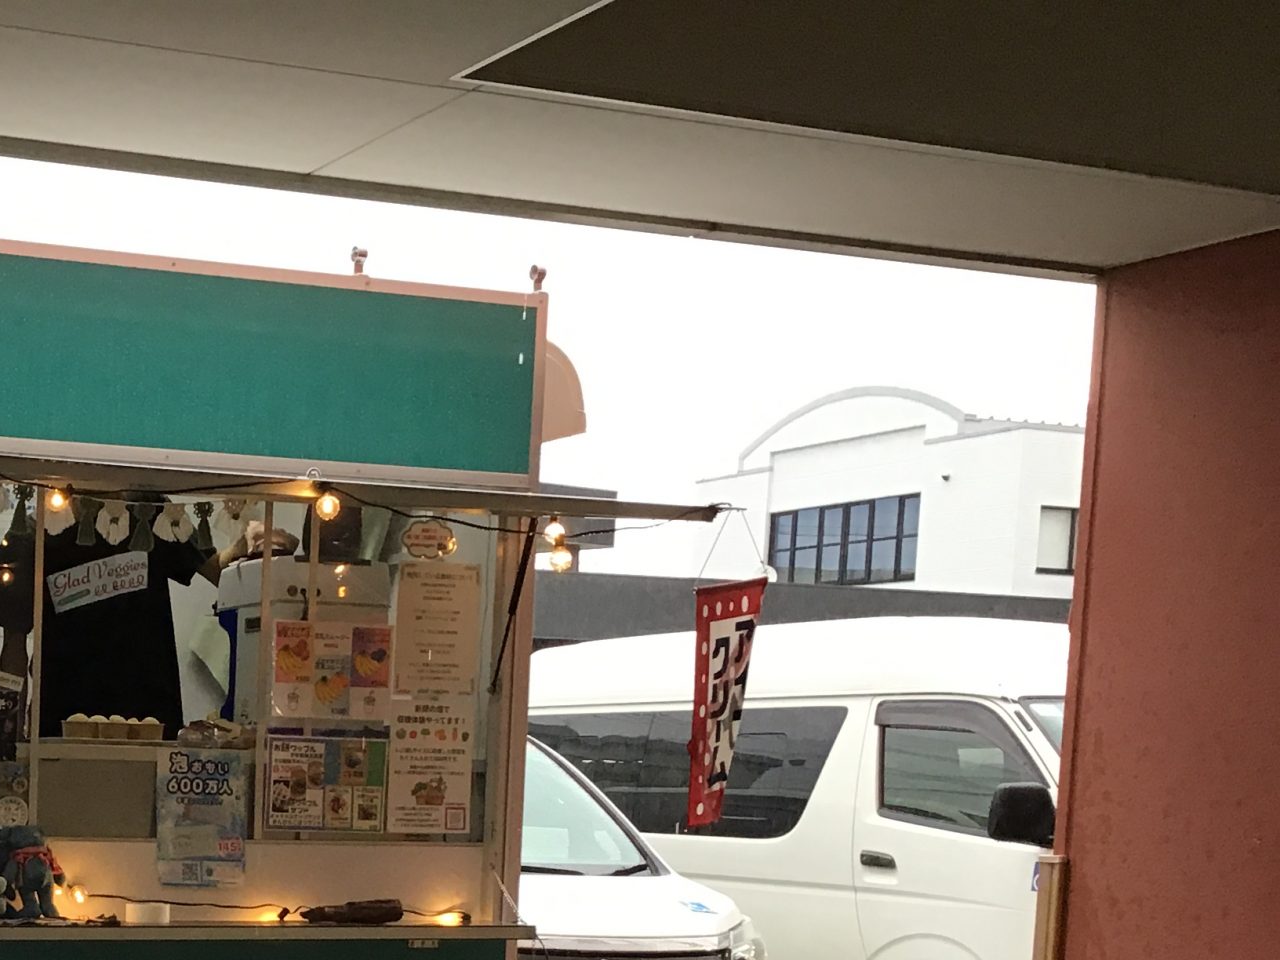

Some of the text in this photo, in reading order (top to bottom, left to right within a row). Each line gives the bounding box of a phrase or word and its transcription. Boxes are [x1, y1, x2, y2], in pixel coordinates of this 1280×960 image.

[53, 560, 147, 596] Glad Veggies
[707, 636, 730, 788] クリーム
[167, 776, 233, 796] 600万人
